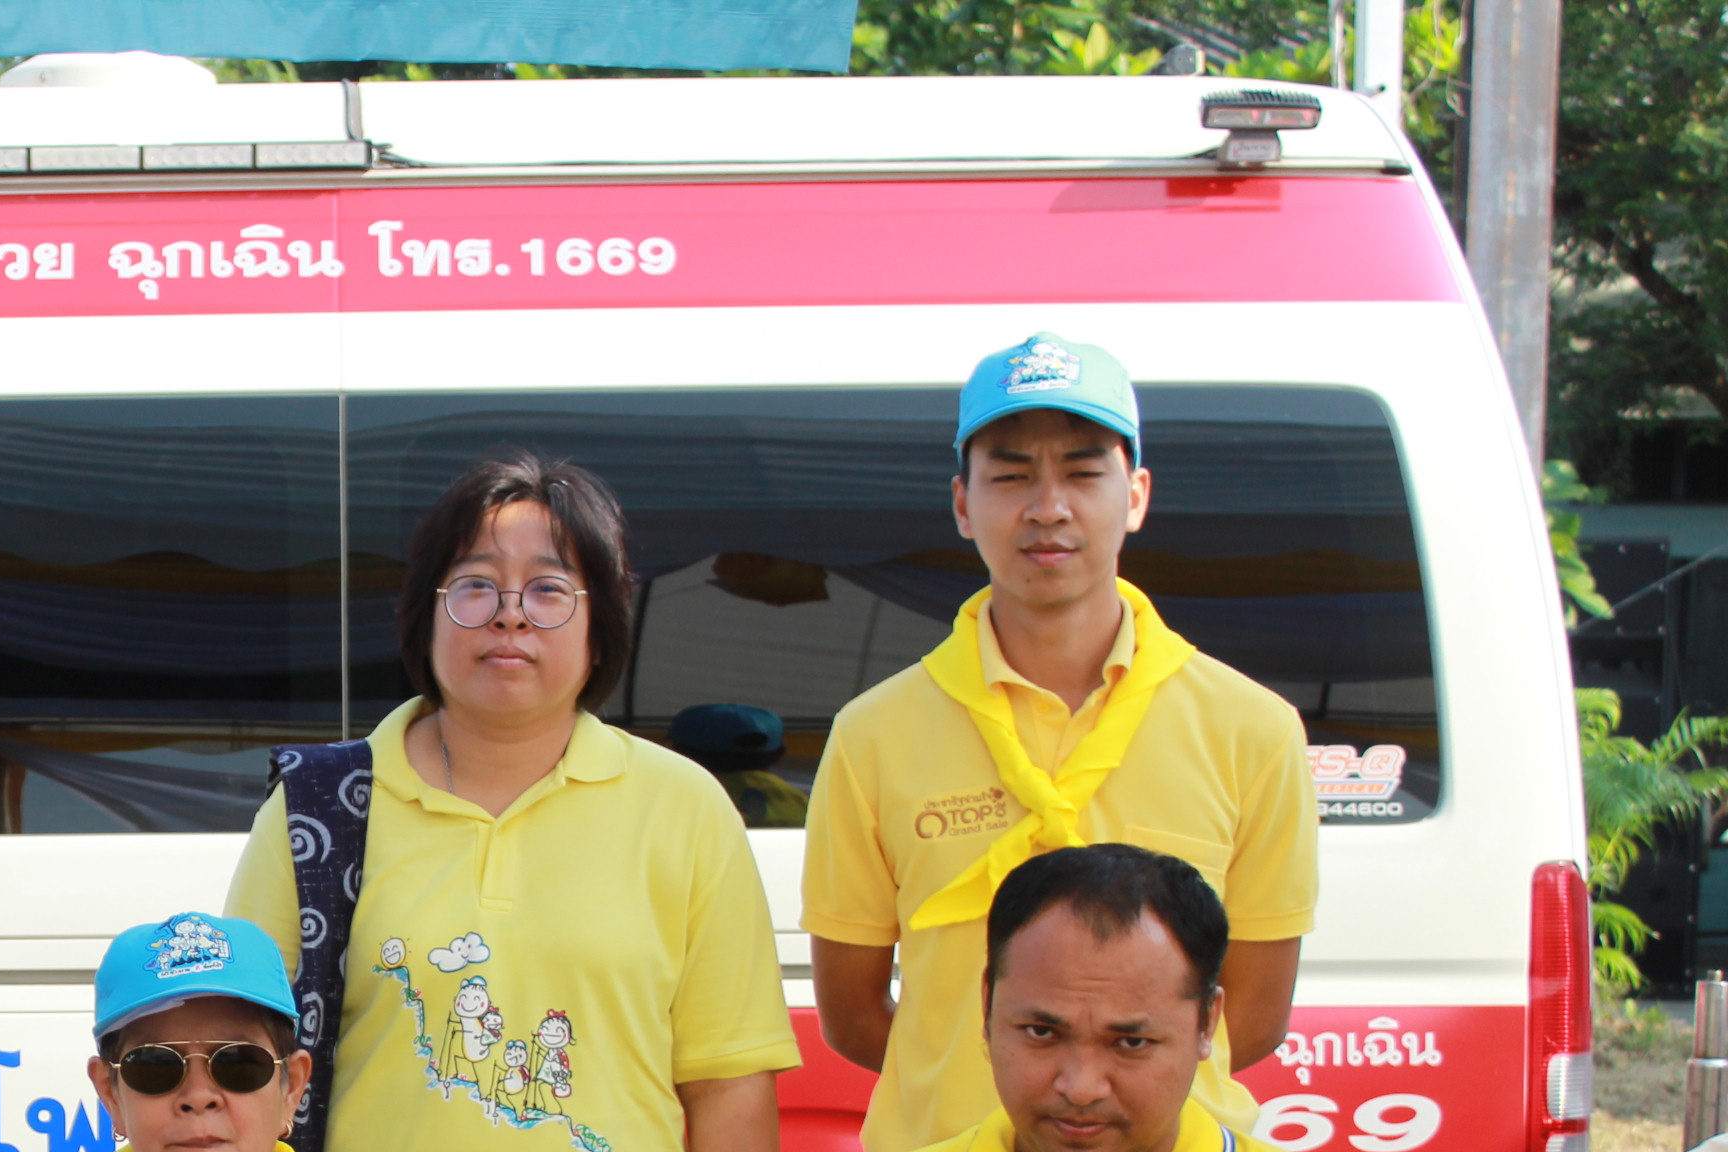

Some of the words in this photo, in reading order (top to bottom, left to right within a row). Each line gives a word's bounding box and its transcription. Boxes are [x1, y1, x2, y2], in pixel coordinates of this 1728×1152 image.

[108, 223, 345, 300] ฉุกเฉิน
[1274, 1015, 1442, 1086] ฉุกเฉิน
